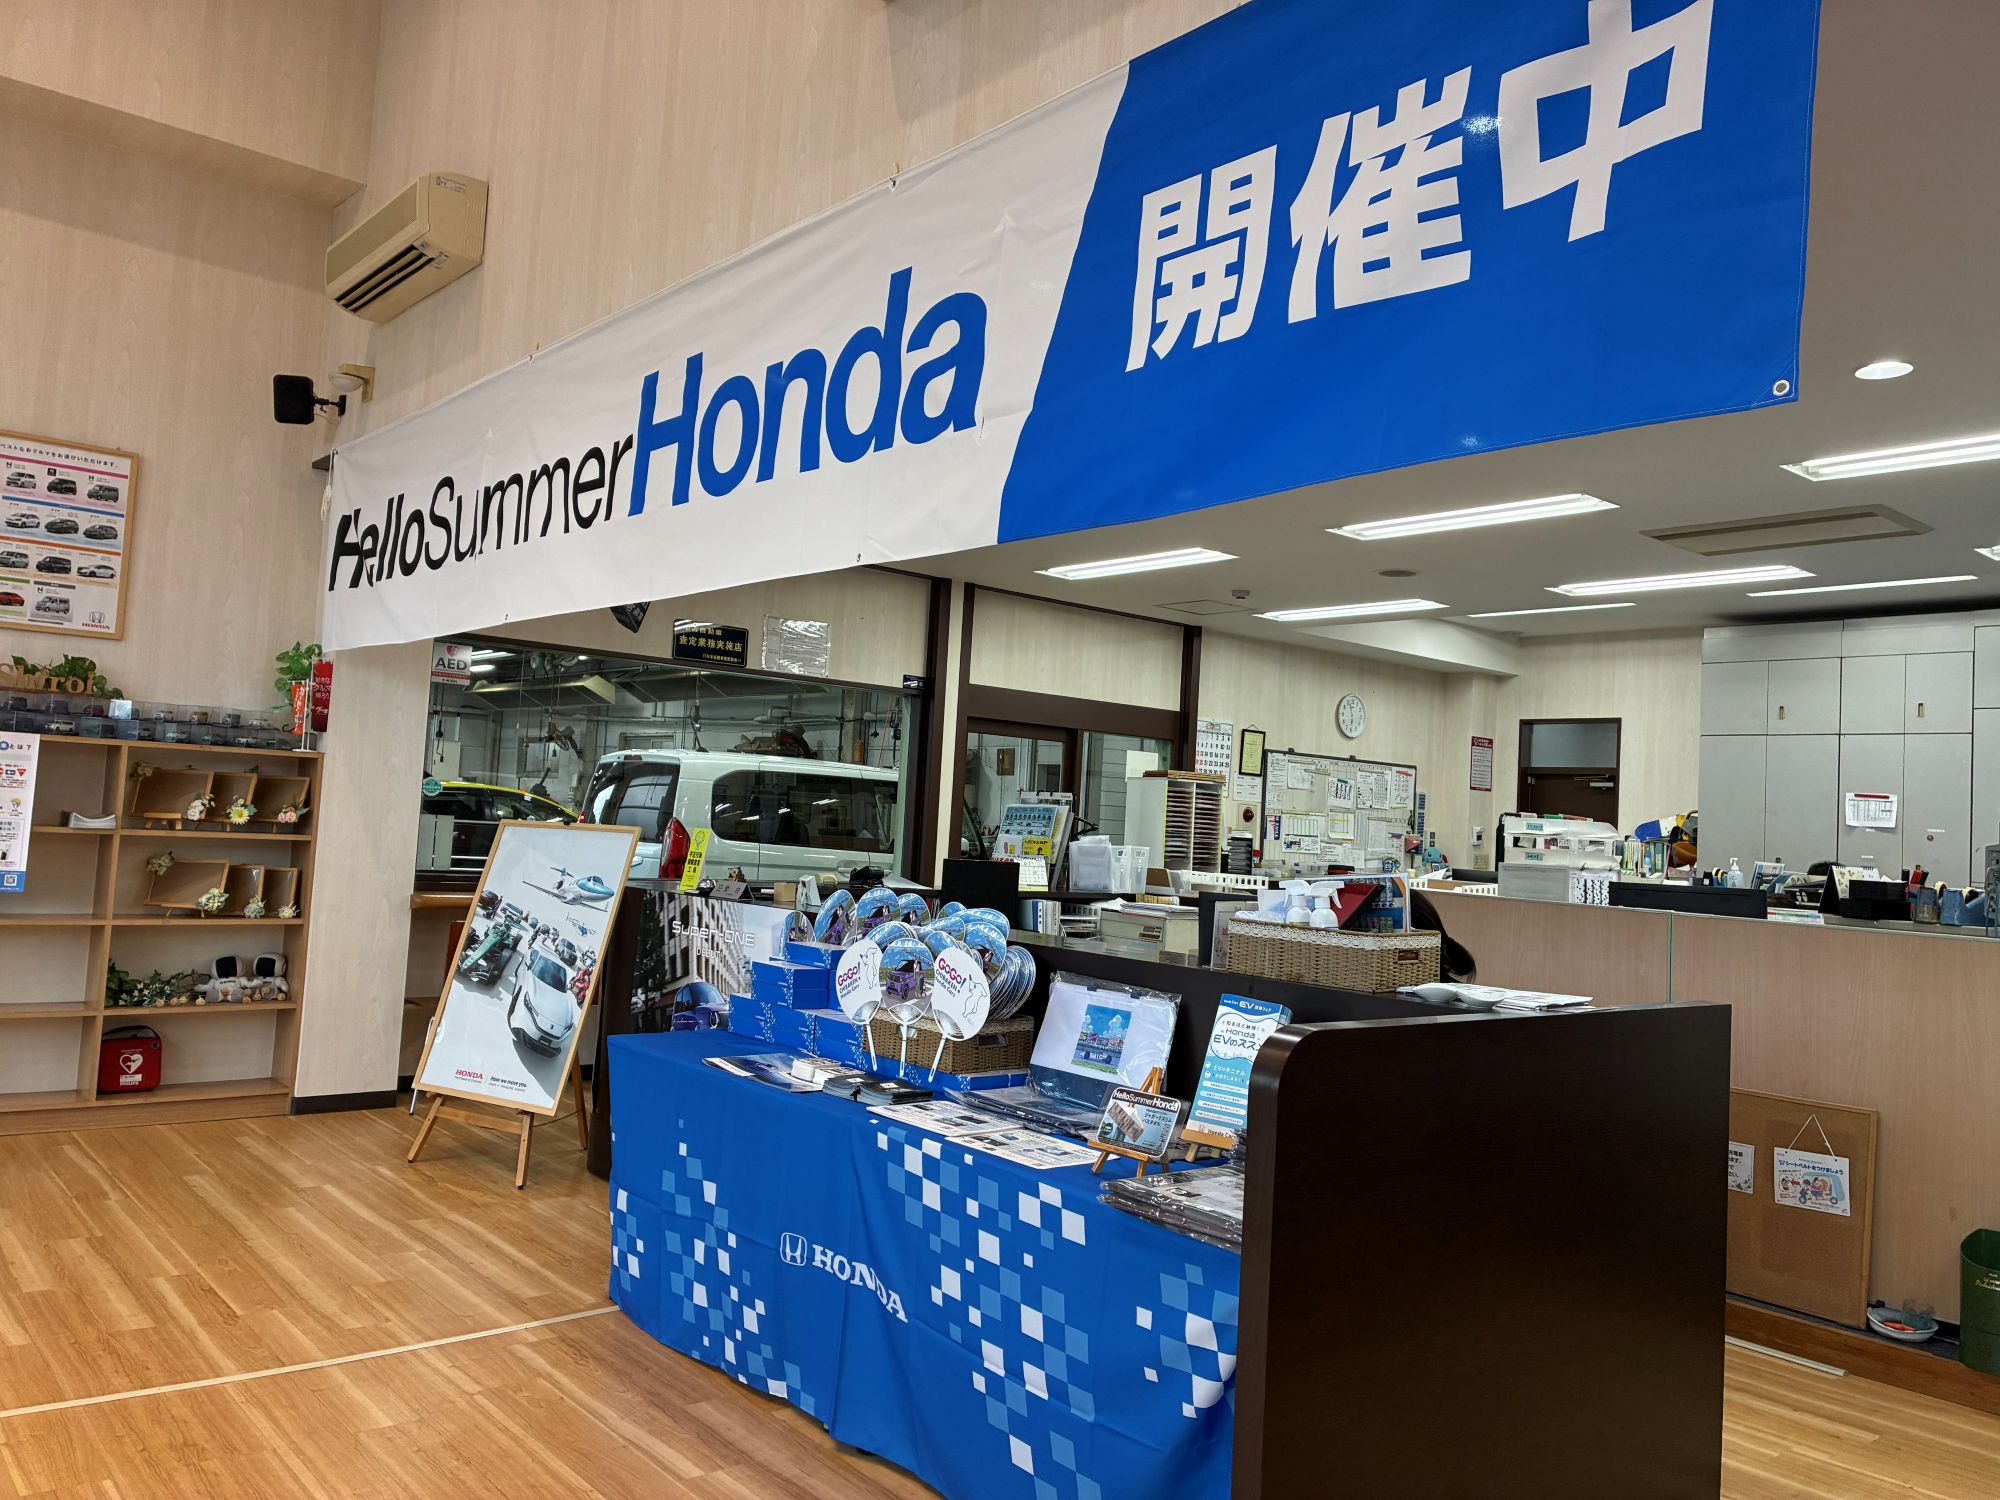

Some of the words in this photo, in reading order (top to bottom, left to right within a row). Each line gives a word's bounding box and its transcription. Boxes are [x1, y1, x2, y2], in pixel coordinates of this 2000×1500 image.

[1126, 0, 1713, 372] 開催中
[82, 622, 111, 631] HONDA
[679, 634, 743, 652] 査定業務実施店
[435, 656, 468, 671] AED
[1239, 1000, 1255, 1010] EV
[1225, 1028, 1256, 1040] Honda
[455, 1068, 484, 1080] HONDA
[811, 1244, 909, 1324] HONDA
